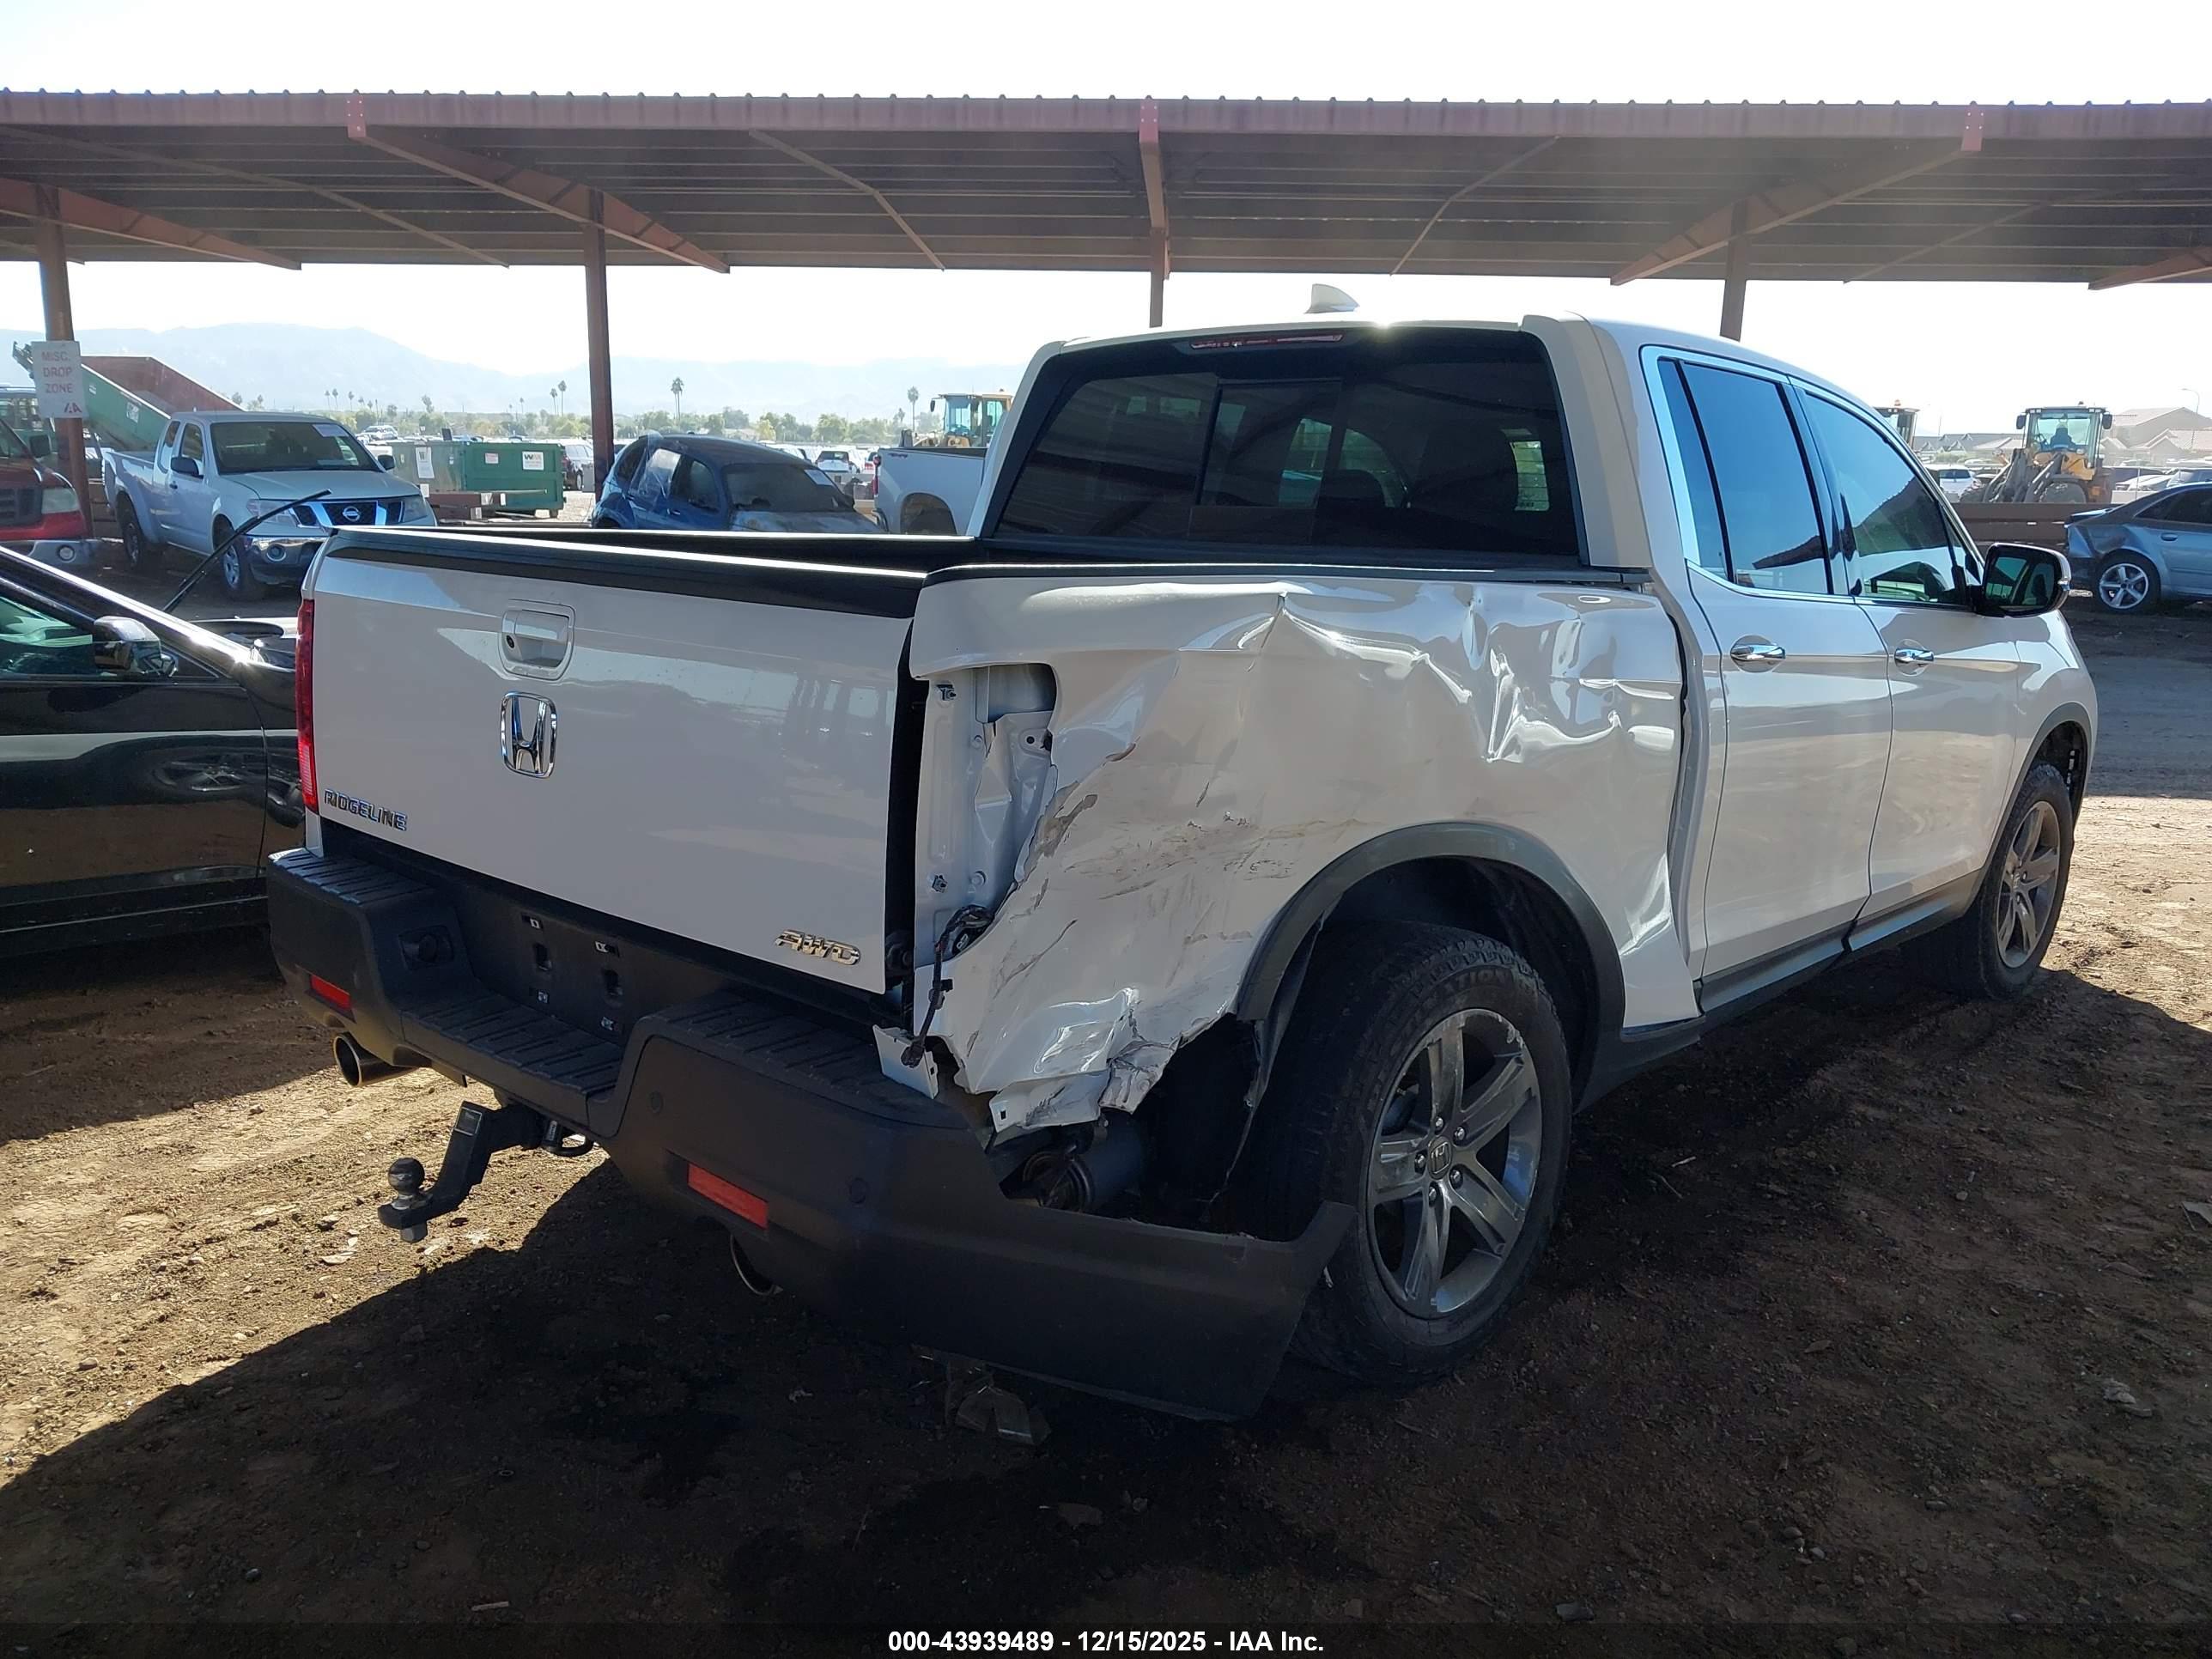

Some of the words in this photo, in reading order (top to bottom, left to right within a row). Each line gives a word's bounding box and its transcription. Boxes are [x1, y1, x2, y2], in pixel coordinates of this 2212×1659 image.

[43, 367, 72, 378] DROP
[46, 383, 74, 393] ZONE
[324, 789, 408, 831] RIDGELINE
[775, 929, 860, 965] AWD
